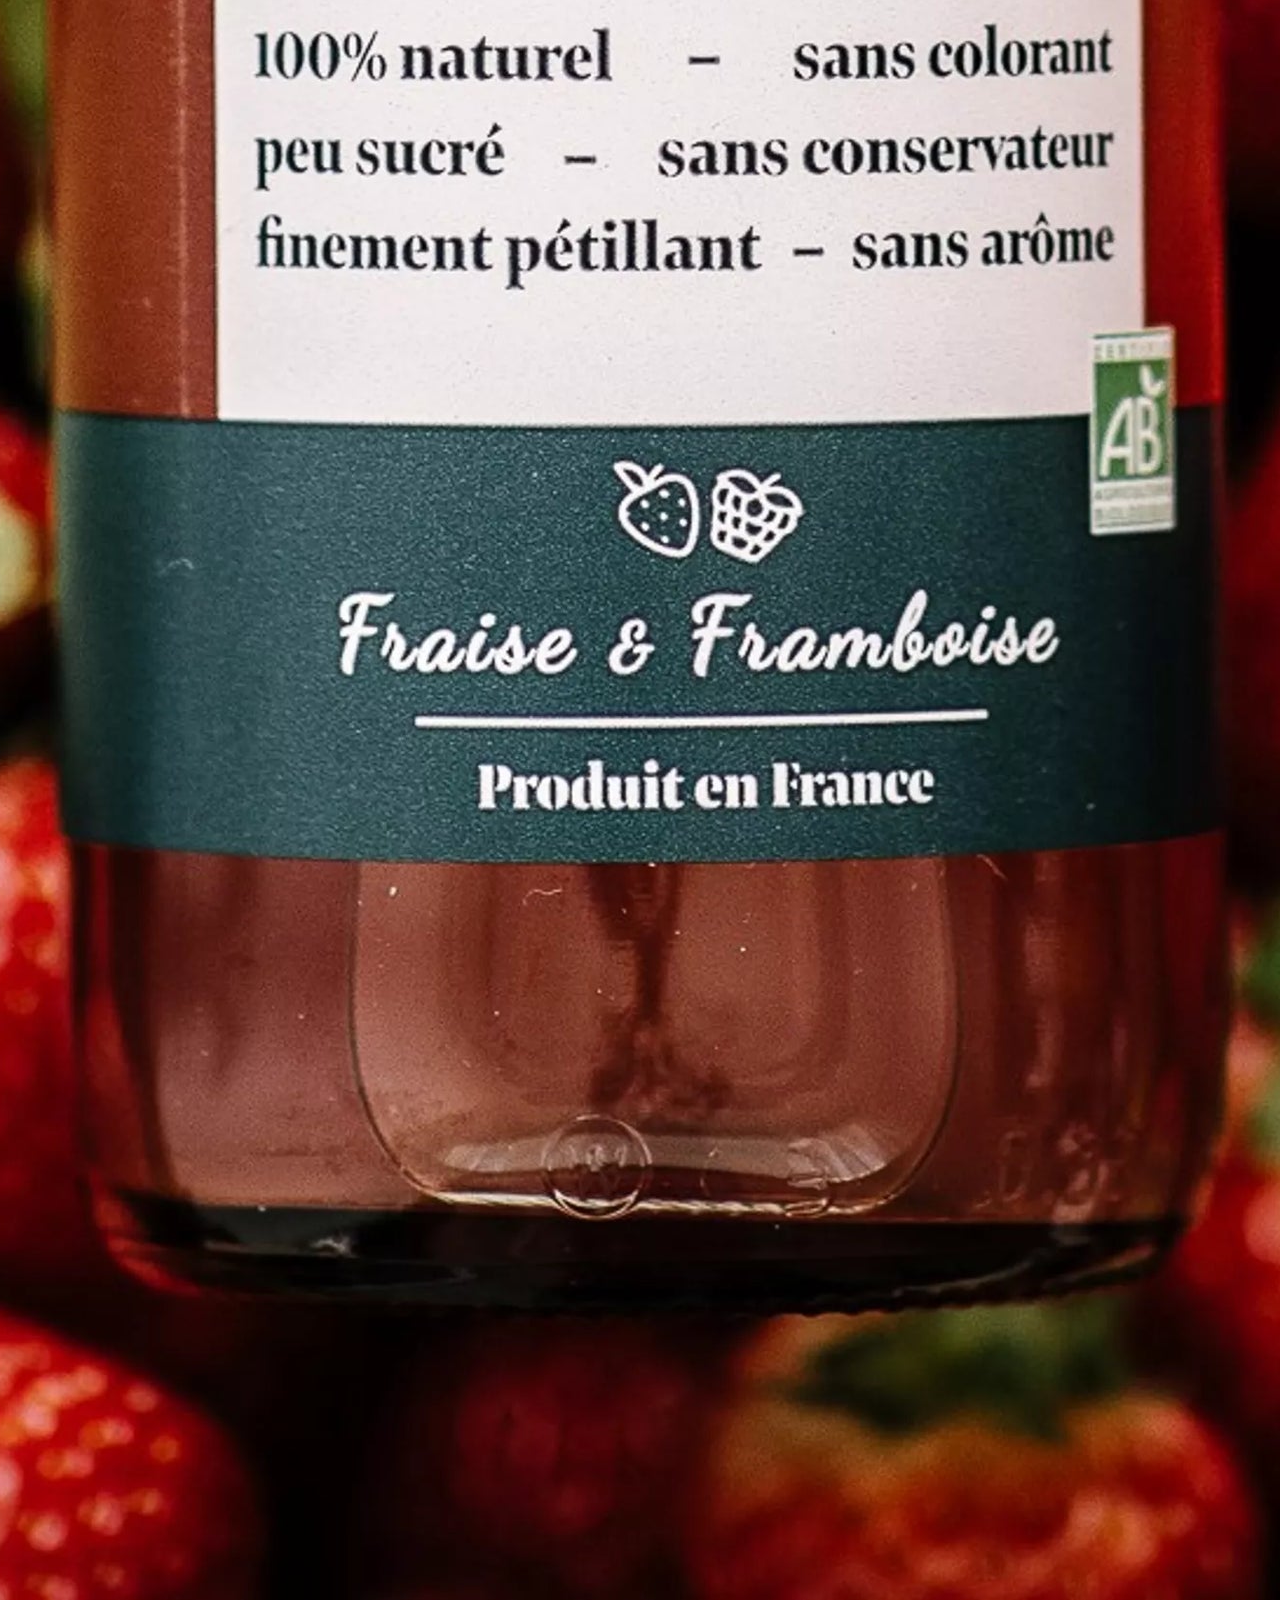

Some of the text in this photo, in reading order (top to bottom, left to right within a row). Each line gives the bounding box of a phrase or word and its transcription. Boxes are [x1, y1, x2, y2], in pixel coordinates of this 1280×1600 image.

[254, 30, 388, 83] 100%
[399, 27, 613, 82] naturel
[792, 41, 916, 81] sans
[927, 23, 1114, 79] colorant
[254, 137, 344, 192] peu
[355, 121, 506, 177] sucré
[657, 138, 790, 179] sans
[802, 125, 1115, 176] conservateur
[256, 213, 494, 272] finement
[504, 217, 763, 291] pétillant
[851, 230, 970, 271] sans
[980, 211, 1116, 267] arôme
[1097, 394, 1165, 480] AB
[338, 588, 1060, 679] Fraise & Framboise
[476, 757, 935, 812] Produit en France
